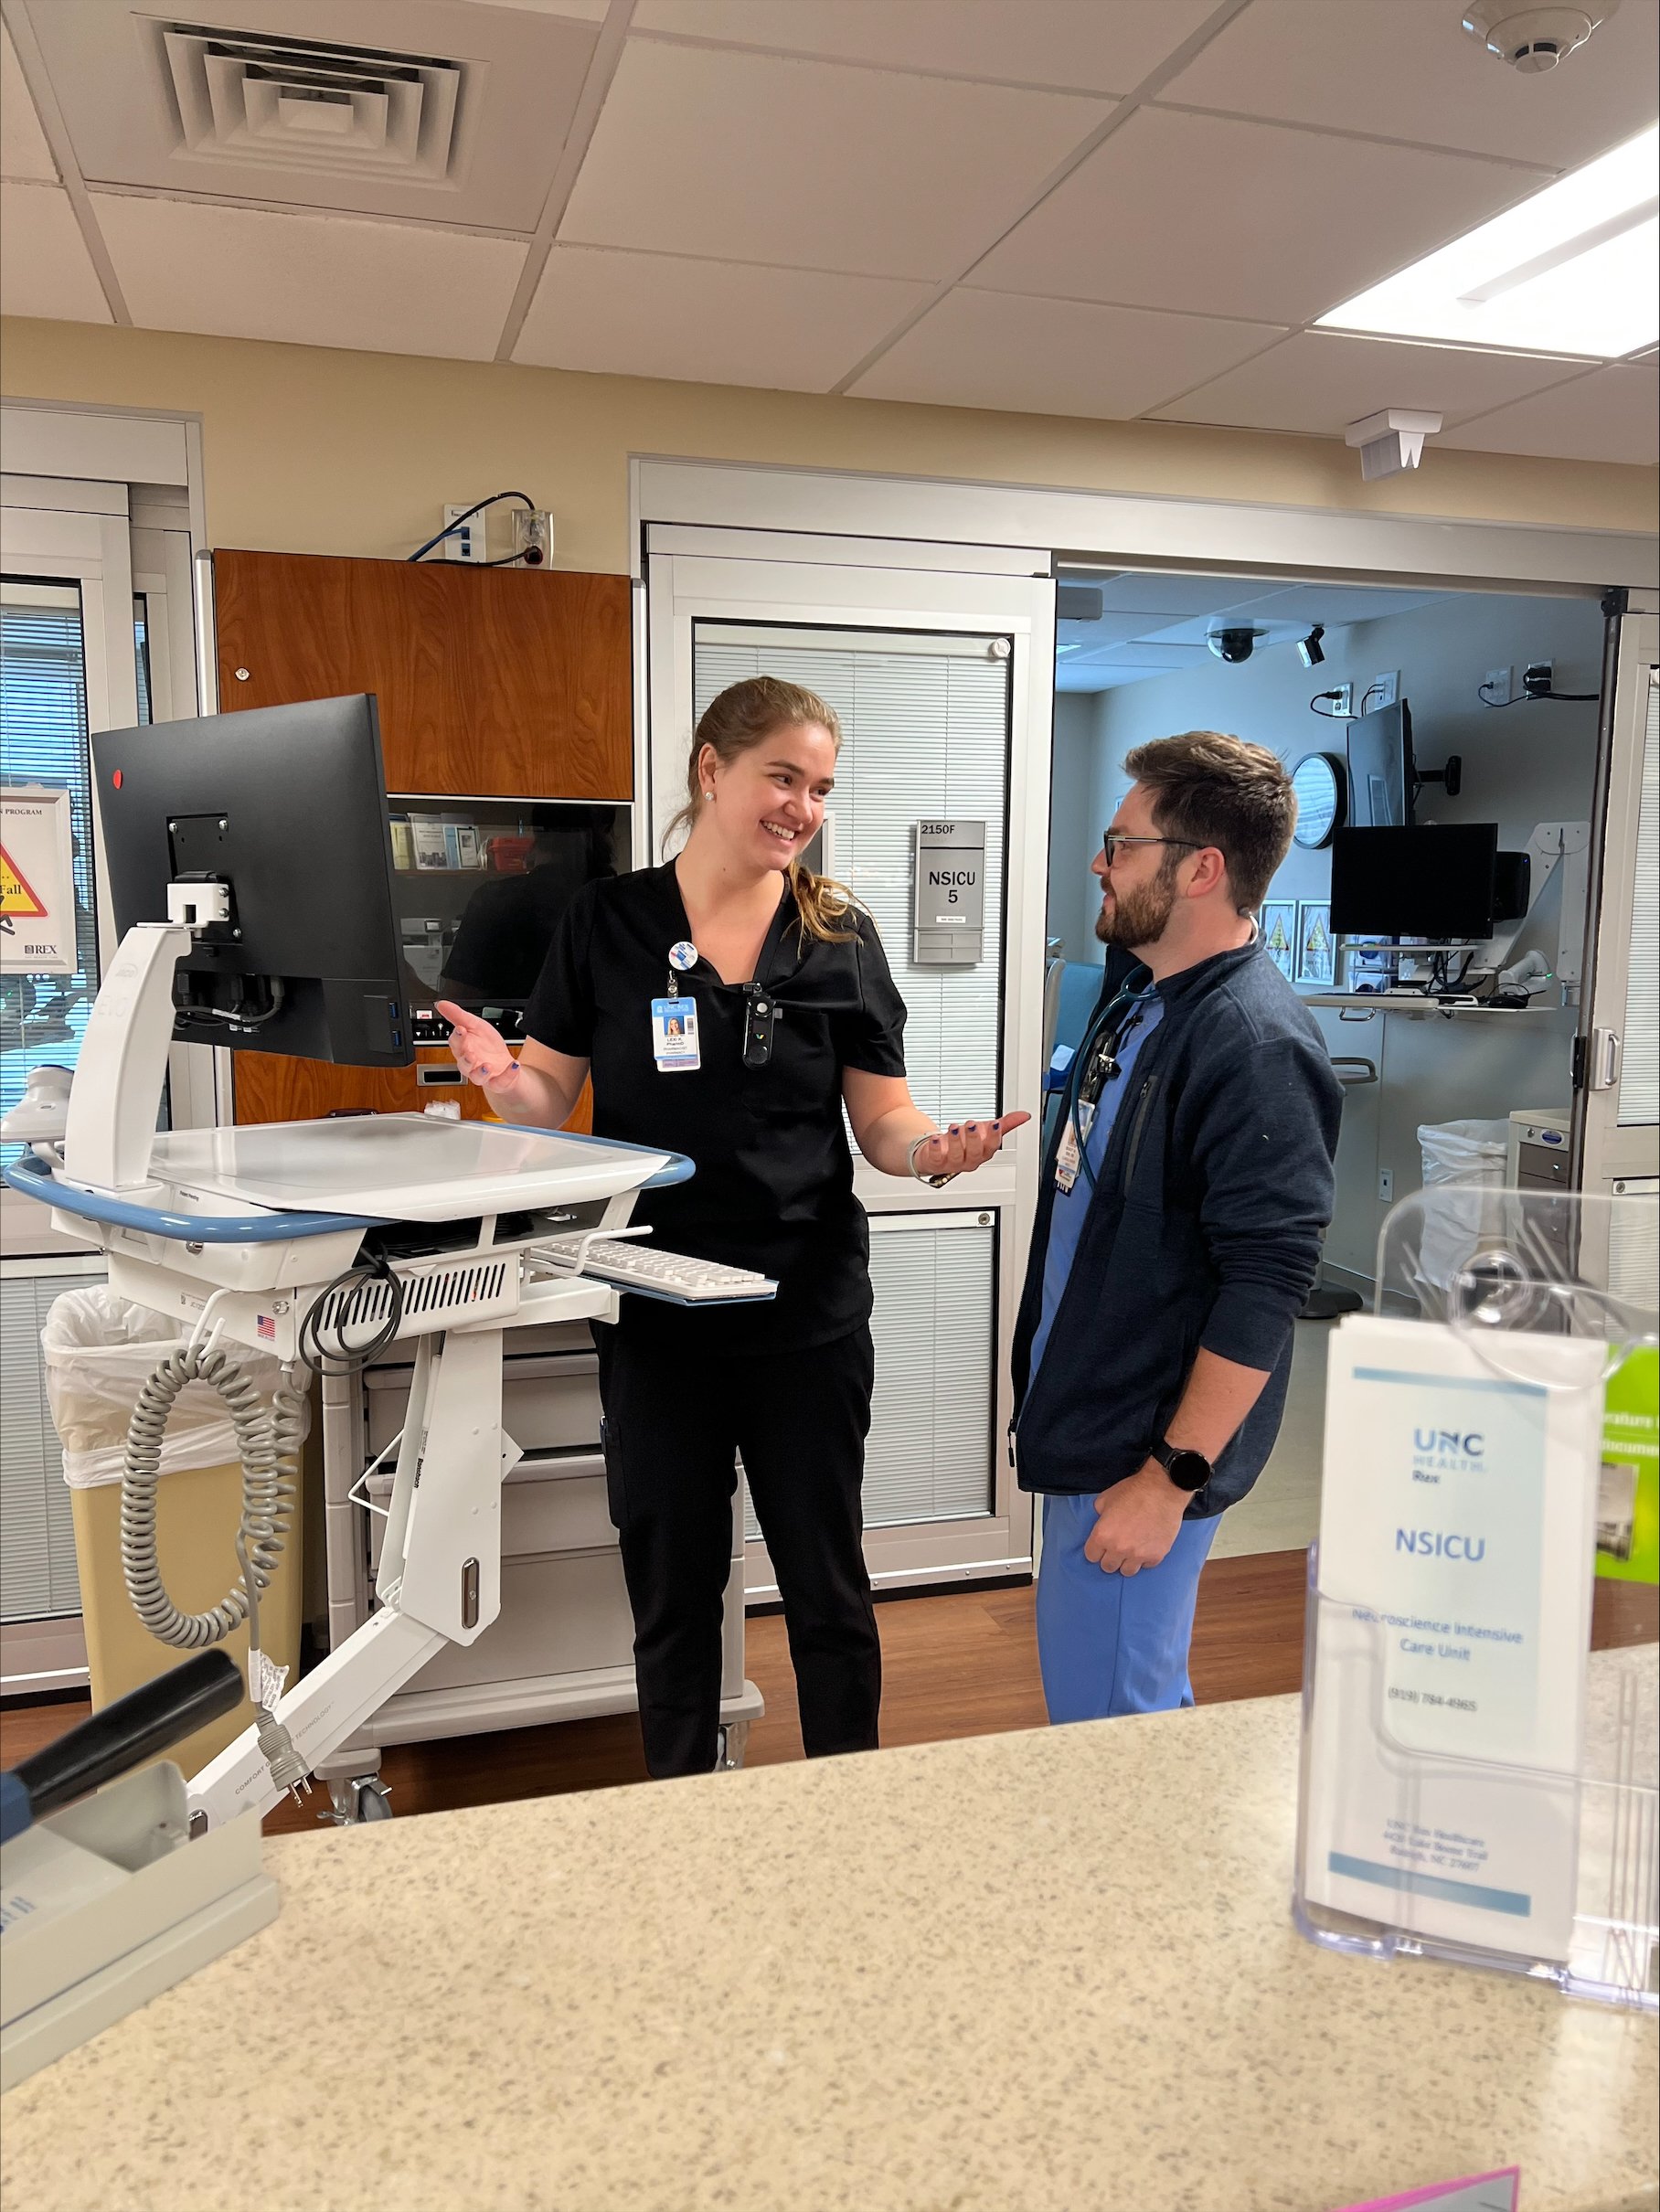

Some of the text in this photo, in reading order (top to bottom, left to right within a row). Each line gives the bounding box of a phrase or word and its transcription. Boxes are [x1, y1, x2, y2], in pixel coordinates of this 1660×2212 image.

[921, 824, 955, 835] 2150F
[929, 871, 975, 886] NSICU
[0, 885, 21, 895] Fall
[948, 889, 958, 903] 5
[36, 945, 57, 954] REX
[1413, 1428, 1484, 1457] UNC
[1411, 1469, 1441, 1484] Rex
[1395, 1527, 1486, 1563] NSICU
[1454, 1622, 1524, 1644] Intensive
[1399, 1637, 1471, 1662] Care Unit
[1388, 1686, 1419, 1704] (919)
[235, 1765, 264, 1795] COMFORT
